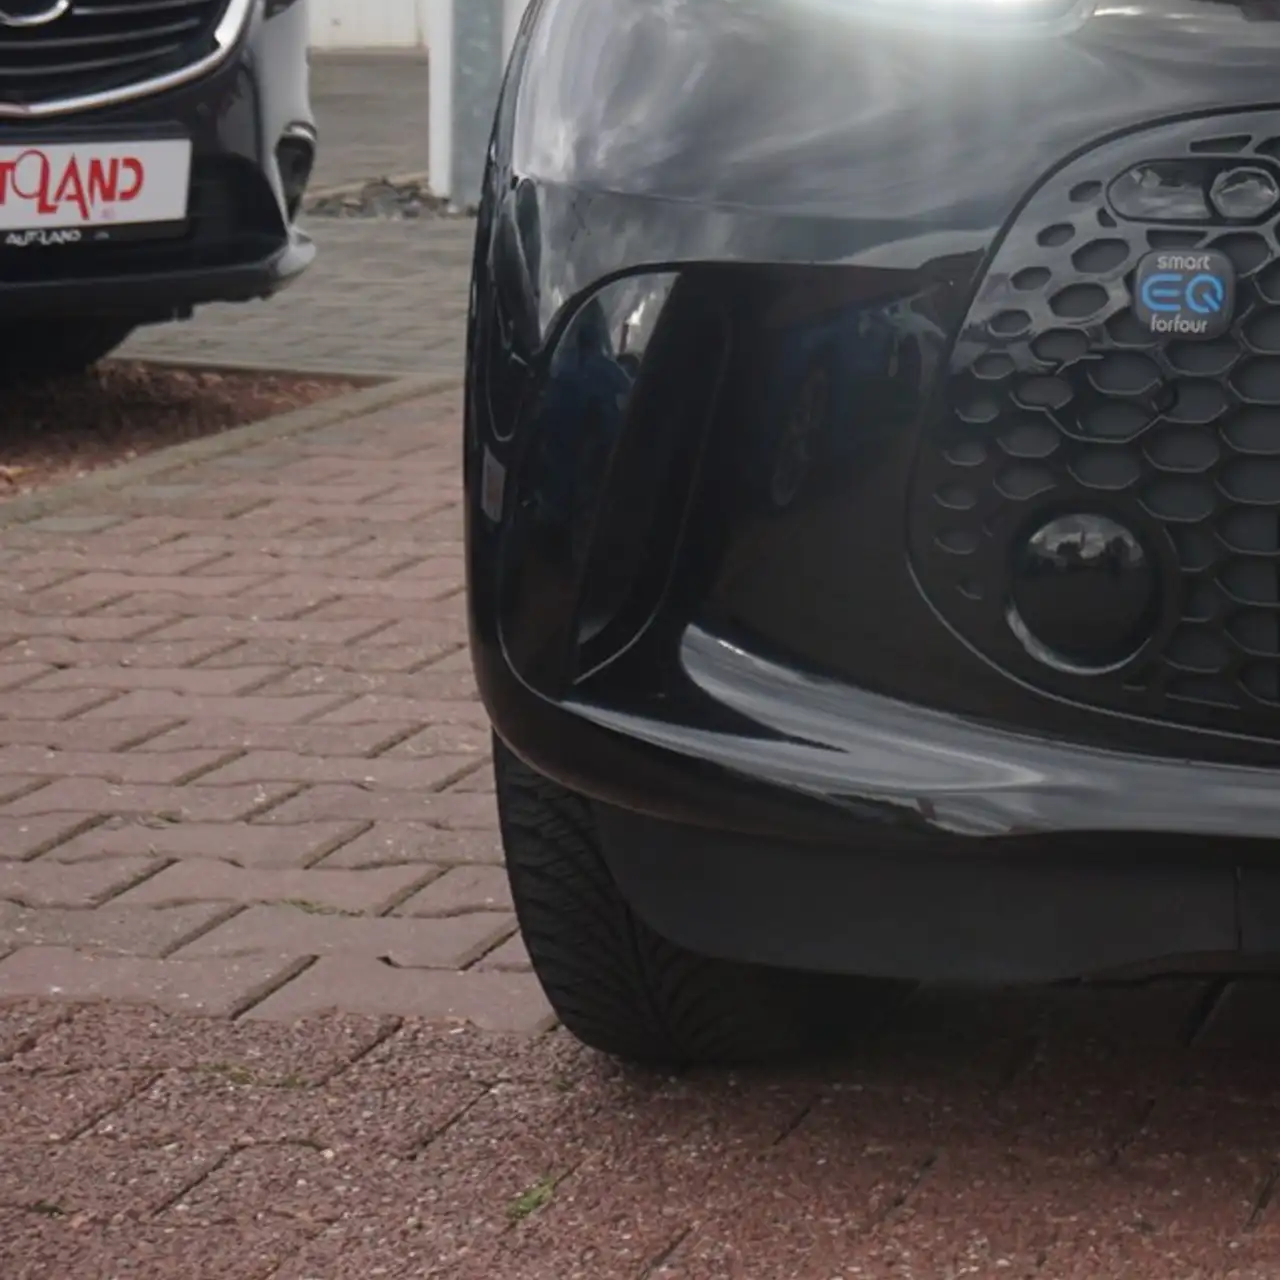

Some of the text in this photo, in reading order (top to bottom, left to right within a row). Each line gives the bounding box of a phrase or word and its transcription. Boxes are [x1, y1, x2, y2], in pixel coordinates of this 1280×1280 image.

[1156, 255, 1211, 270] smart
[1141, 273, 1223, 313] EQ
[1151, 314, 1208, 333] forfour
